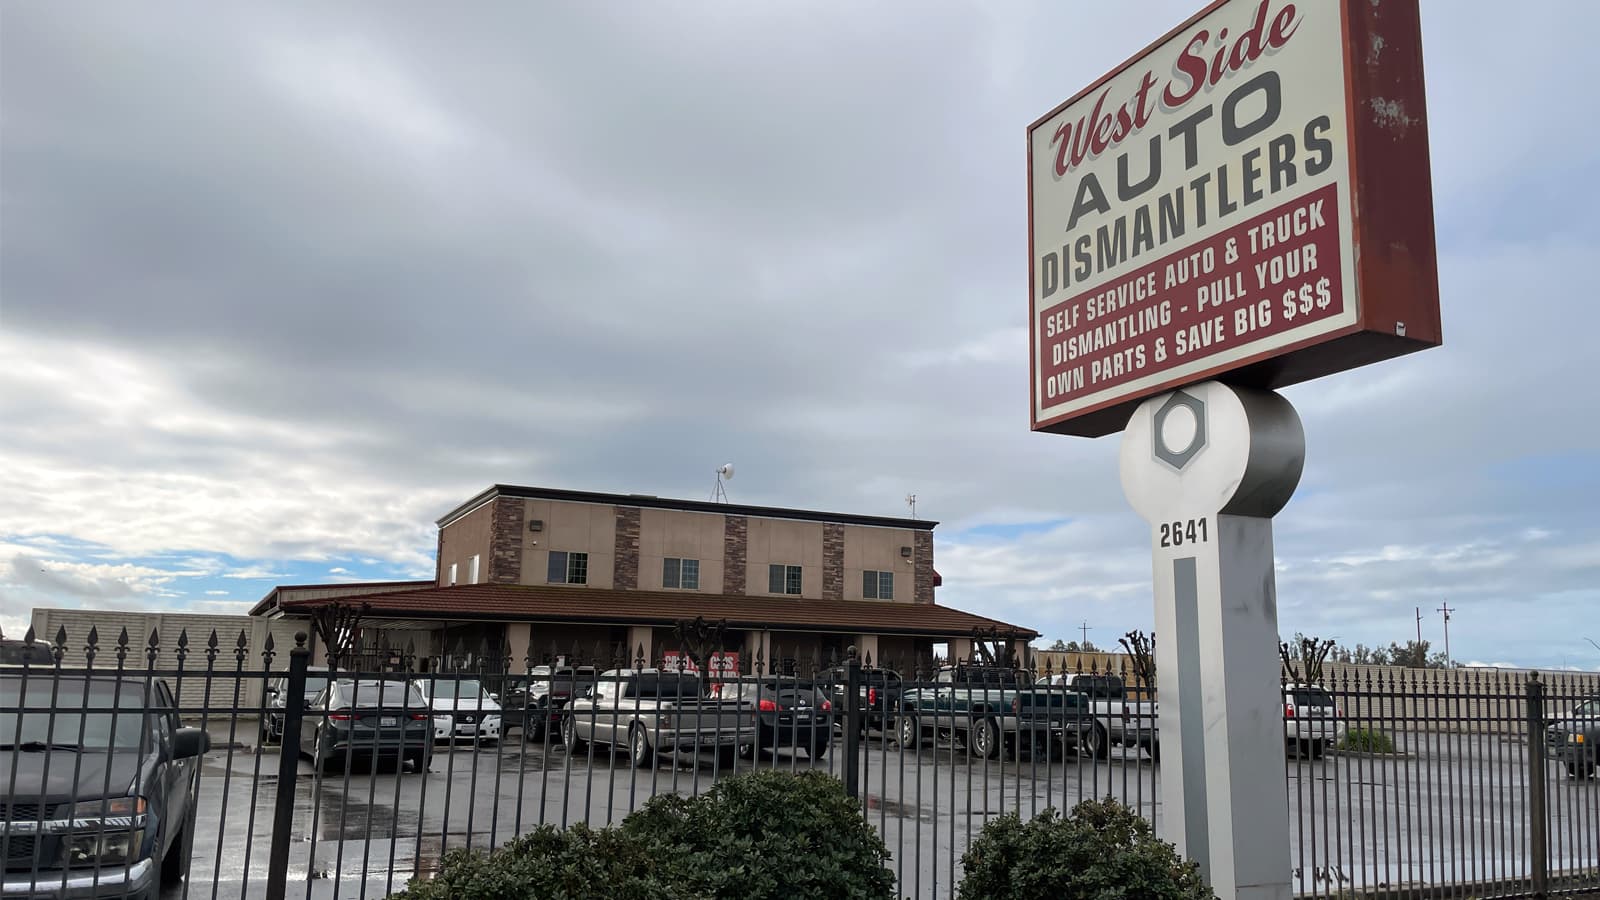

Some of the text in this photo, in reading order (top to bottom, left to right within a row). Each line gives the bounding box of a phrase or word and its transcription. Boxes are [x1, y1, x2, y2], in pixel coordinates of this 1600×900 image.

[1051, 0, 1304, 178] West Side
[1066, 71, 1281, 232] AUTO
[1042, 115, 1332, 299] DISMANTLERS
[1047, 199, 1325, 338] SELF SERVICE AUTO & TRUCK
[1047, 276, 1331, 399] OWN PARTS & SAVE BIG $$$
[1053, 300, 1171, 366] DISMANTLING
[1198, 272, 1246, 312] PULL
[1255, 243, 1317, 290] YOUR
[1160, 517, 1207, 548] 2641
